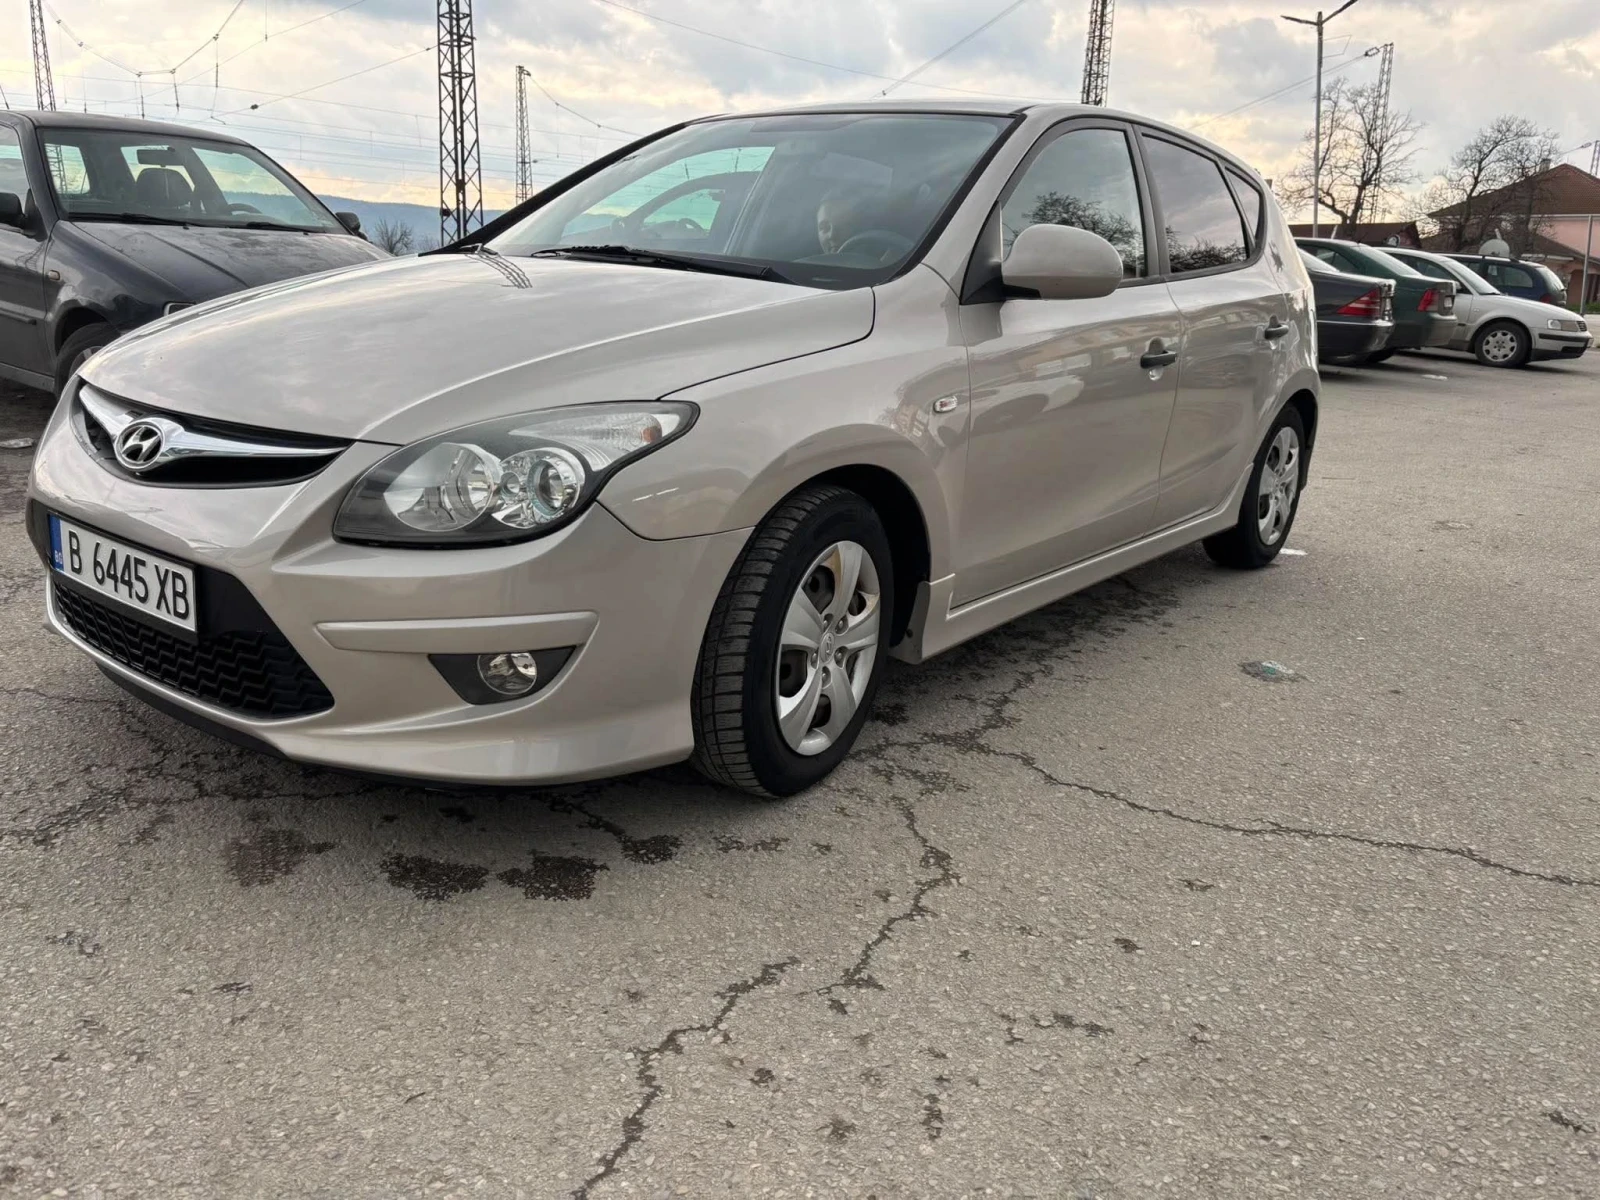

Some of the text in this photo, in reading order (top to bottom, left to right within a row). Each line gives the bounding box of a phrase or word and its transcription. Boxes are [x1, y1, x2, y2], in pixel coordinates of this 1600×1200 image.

[68, 530, 190, 620] B 6445 XB
